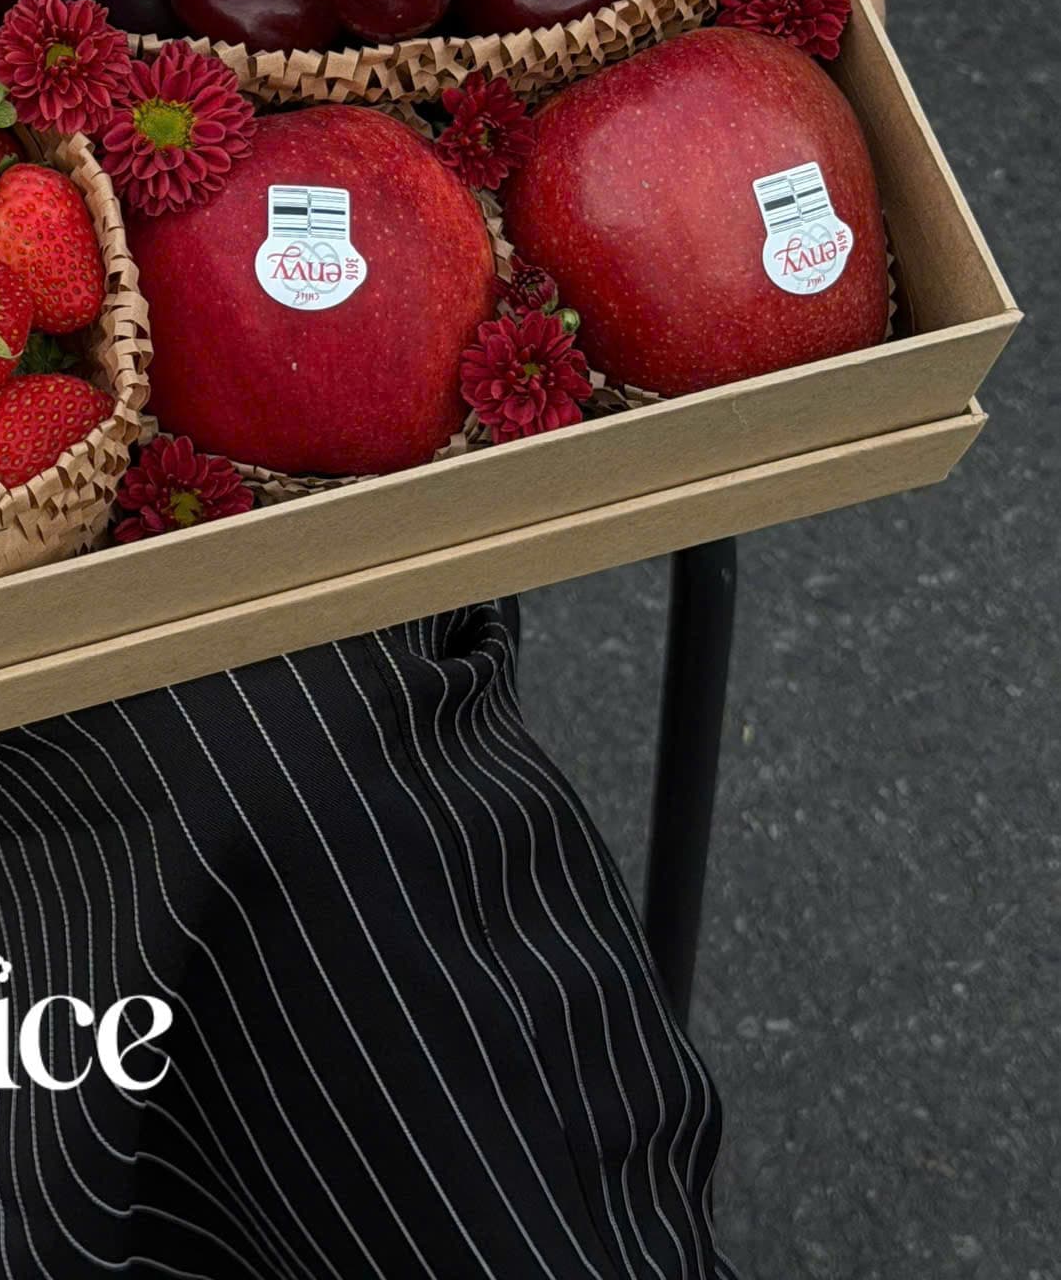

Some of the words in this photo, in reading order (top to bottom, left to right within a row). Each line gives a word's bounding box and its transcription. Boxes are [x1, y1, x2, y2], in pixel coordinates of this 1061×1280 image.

[267, 246, 342, 284] envy
[345, 257, 359, 280] 3616
[773, 238, 837, 275] envy
